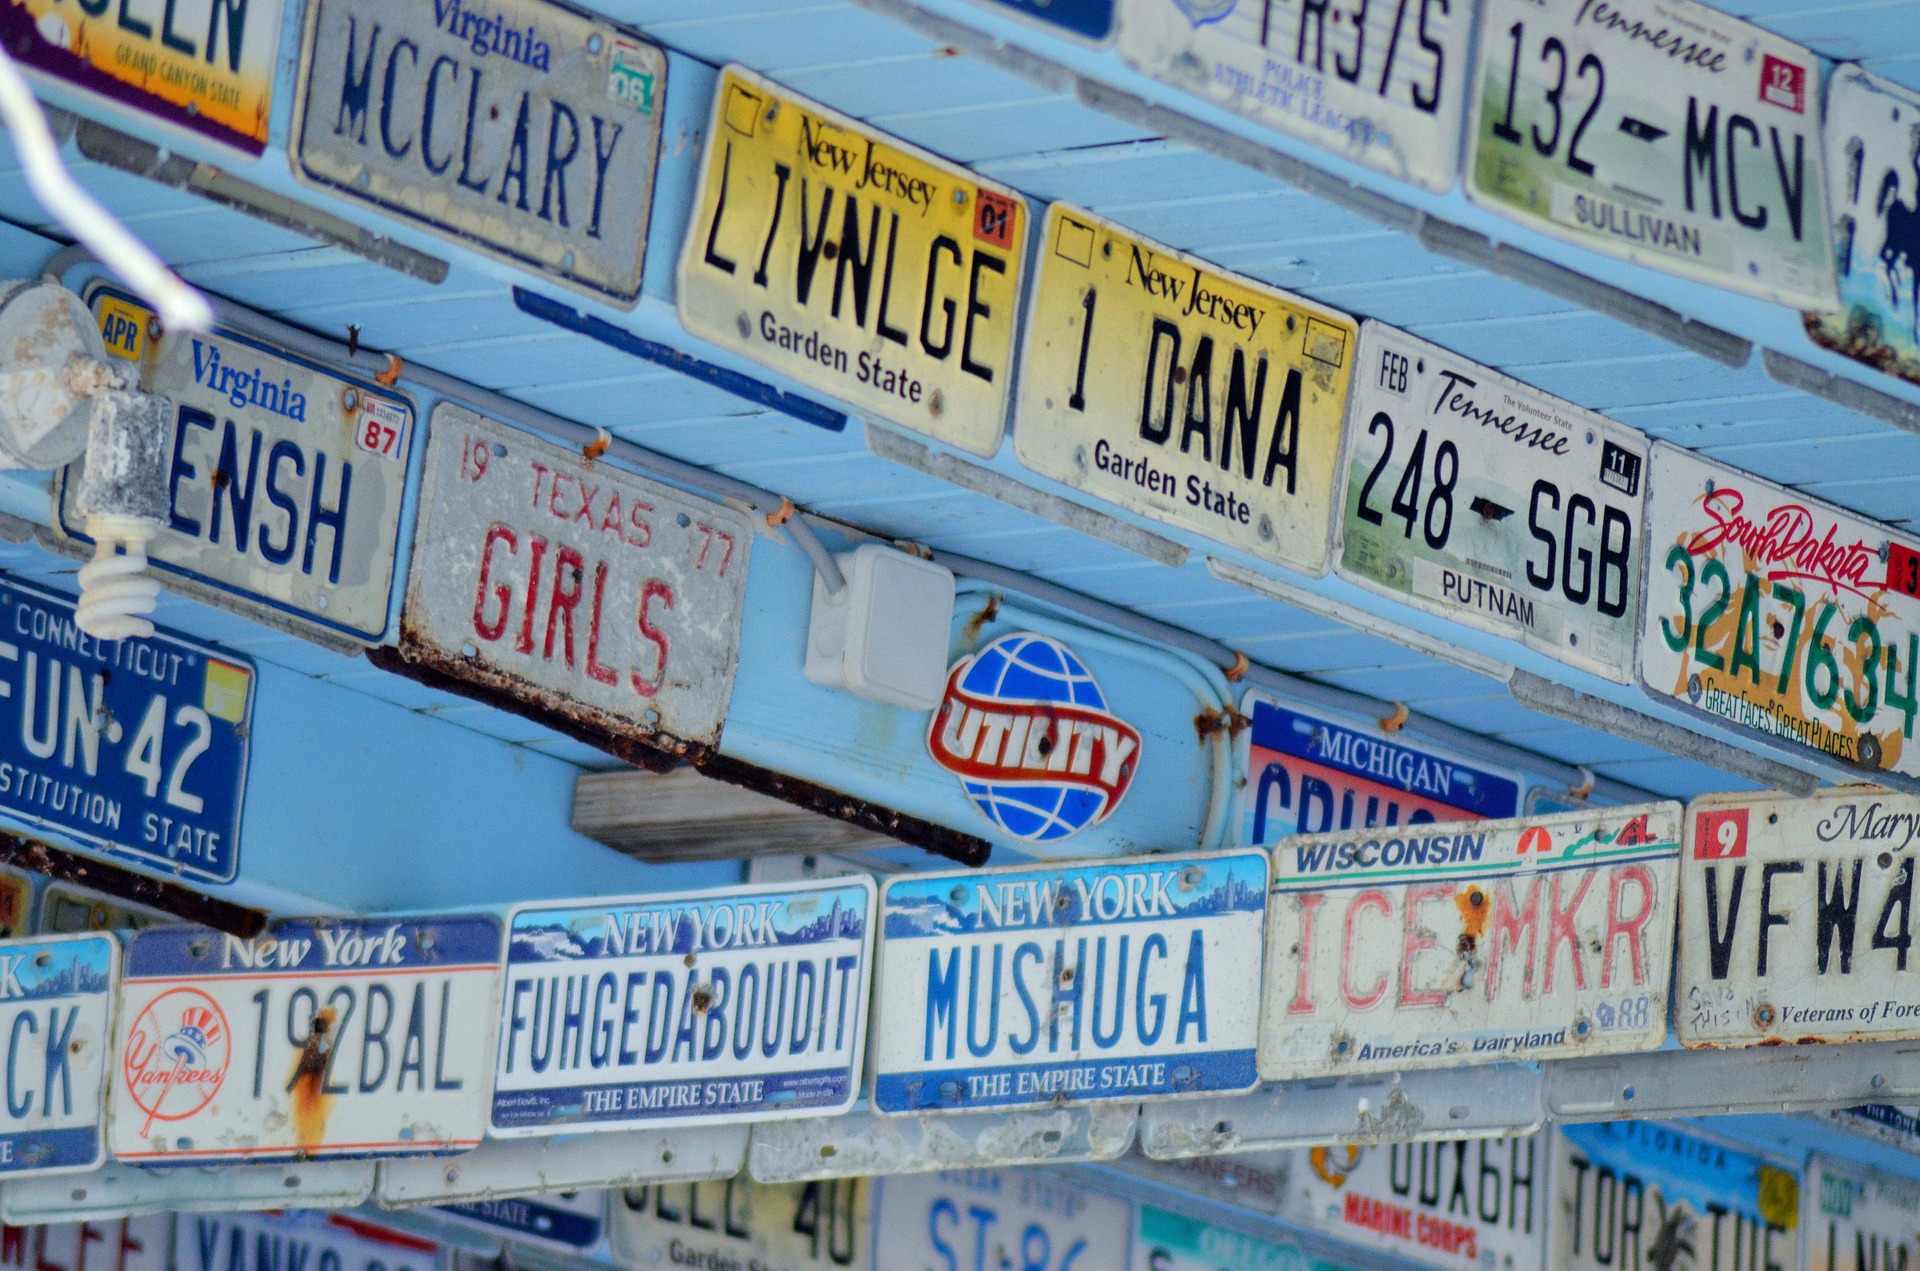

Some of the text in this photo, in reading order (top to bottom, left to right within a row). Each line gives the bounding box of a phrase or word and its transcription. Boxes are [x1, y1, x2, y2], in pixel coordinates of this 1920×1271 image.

[430, 0, 553, 73] Virginia
[116, 43, 242, 111] GRAND CANYON STATE
[1771, 64, 1794, 92] 12
[333, 15, 624, 242] MCCLARY
[1491, 21, 1805, 243] 132 MCV
[800, 114, 937, 217] New Jersey
[981, 203, 1007, 240] 01
[1574, 194, 1702, 257] SULLIVAN
[704, 139, 1006, 384] LIVNLGE
[1126, 243, 1266, 341] New Jersey
[103, 313, 139, 352] APR
[760, 310, 922, 403] Garden State
[191, 339, 307, 424] Virginia
[1139, 314, 1303, 496] DANA
[1379, 350, 1409, 394] FEB
[364, 421, 397, 455] 87
[1433, 369, 1571, 456] Tennessee
[1503, 394, 1574, 432] The Volunteer State
[1094, 438, 1251, 525] Garden State
[1610, 449, 1626, 475] 11
[460, 434, 736, 577] 19 TEXAS 77
[1687, 487, 1791, 567] South
[1767, 504, 1889, 593] Dakota
[473, 521, 675, 698] GIRLS
[1442, 569, 1535, 629] PUTNAM
[16, 603, 184, 687] CONNECTICUT
[942, 696, 1138, 788] UTILITY
[1705, 677, 1739, 719] GREAT
[1774, 704, 1812, 744] GREAT
[1319, 727, 1453, 797] MICHIGAN
[0, 762, 221, 863] STITUTION STATE
[1717, 820, 1738, 857] 9
[1816, 802, 1920, 852] Mary
[1296, 833, 1487, 874] WISCONSIN
[600, 900, 783, 957] NEW YORK
[975, 870, 1179, 929] NEW YORK
[221, 924, 408, 970] New York
[505, 955, 859, 1075] FUHGEDABOUDIT
[923, 928, 1209, 1063] MUSHUGA
[1616, 996, 1649, 1029] 88
[1781, 1005, 1856, 1024] Veterans
[1859, 1001, 1879, 1024] of
[6, 1005, 81, 1120] CK
[125, 1030, 227, 1090] Yankees
[252, 980, 465, 1100] 192BAL
[1356, 1026, 1566, 1062] America's Dairyland
[584, 1080, 766, 1114] THE EMPIRE STATE
[967, 1063, 1166, 1098] THE EMPIRE STATE
[1627, 1120, 1727, 1168] FLORIDA
[1343, 1190, 1478, 1261] MARINE CORPS
